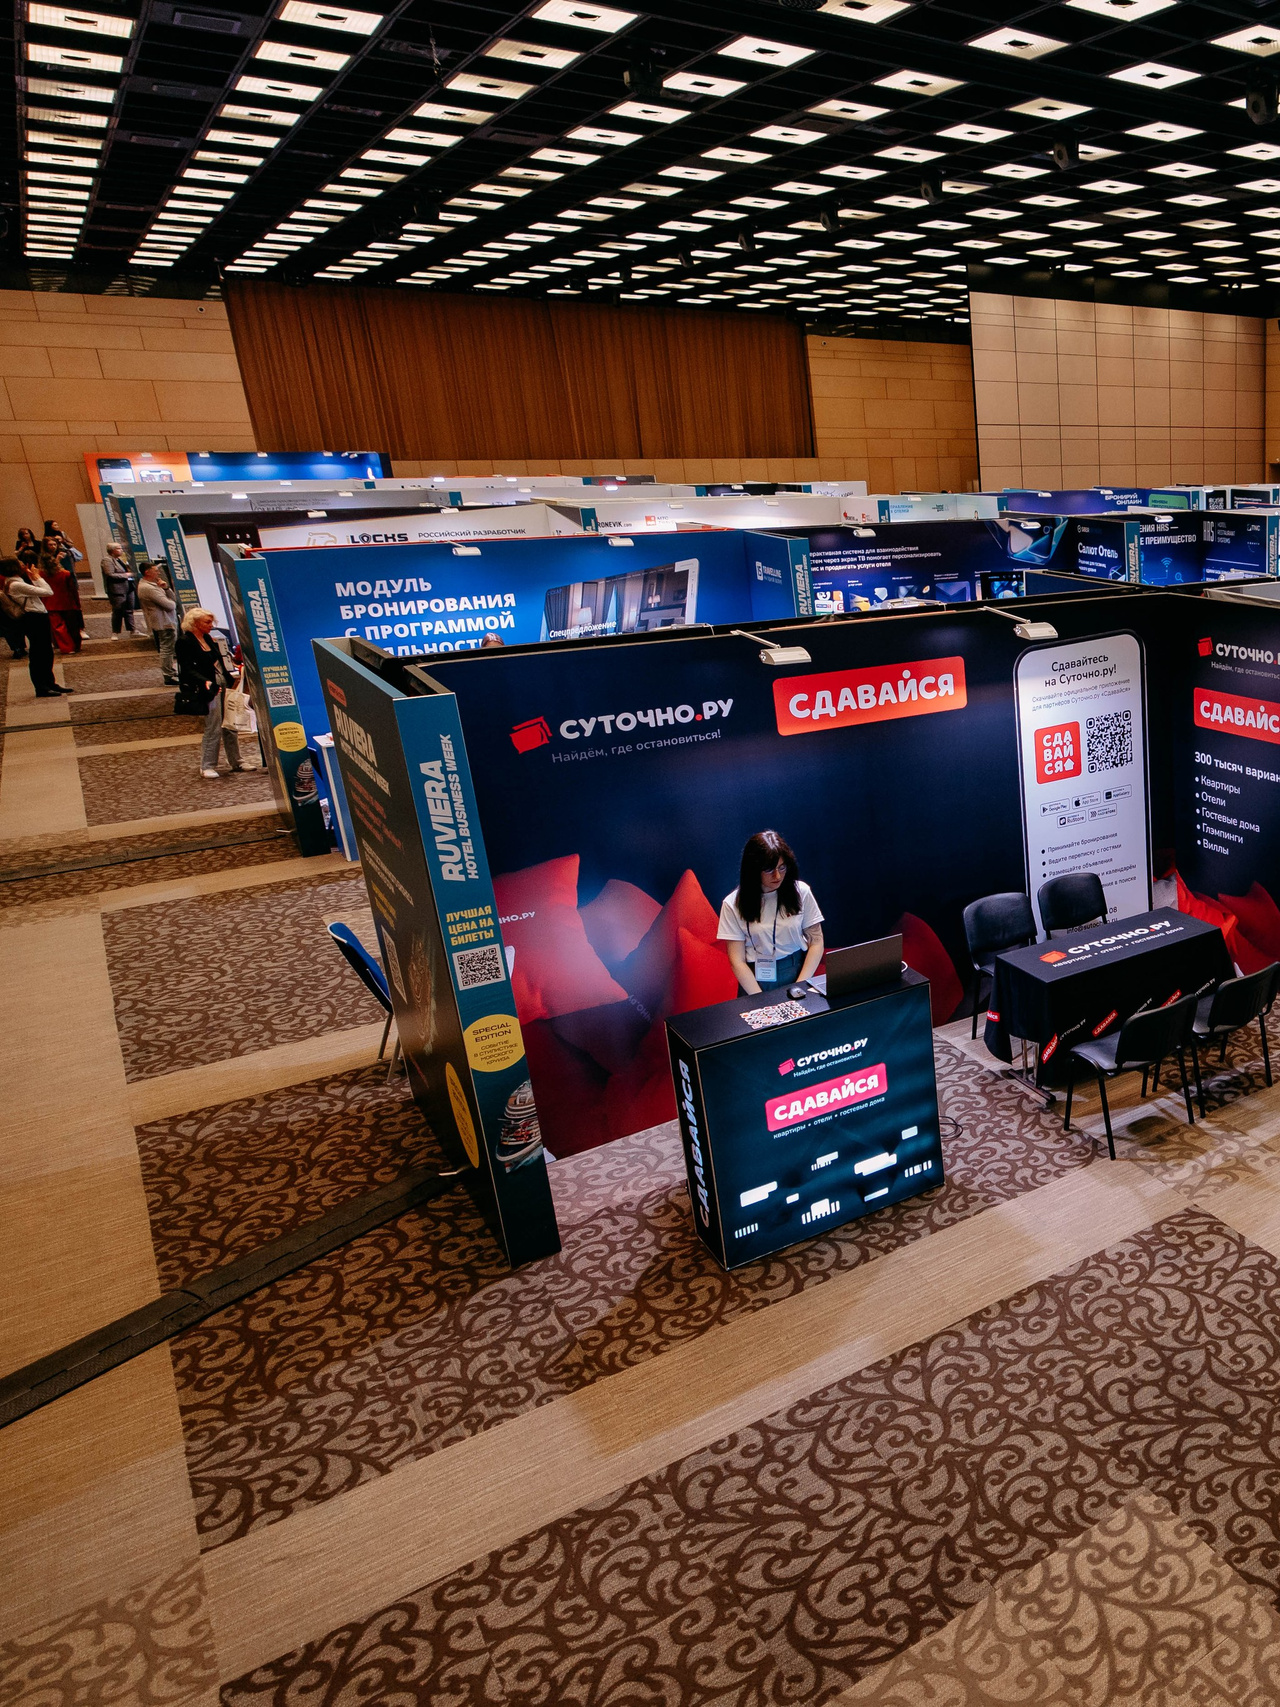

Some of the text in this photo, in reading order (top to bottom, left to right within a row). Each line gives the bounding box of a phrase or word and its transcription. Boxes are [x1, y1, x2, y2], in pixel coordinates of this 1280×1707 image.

[125, 513, 140, 545] RUVIERA
[418, 528, 526, 539] РОССИЙСКИЙ РАЗРАБОТЧИК
[1156, 524, 1169, 532] HRS
[876, 545, 919, 554] взаимодействия
[1077, 541, 1118, 559] Салют Отель
[1145, 534, 1197, 546] ПРЕИМУЩЕСТВО
[166, 538, 186, 580] RUVIERA
[824, 551, 942, 566] через помогает персонализировать
[825, 563, 857, 572] продвигать
[857, 562, 875, 571] услуги
[335, 577, 432, 598] МОДУЛЬ
[795, 564, 808, 615] RUVIERA
[339, 593, 517, 620] БРОНИРОВАНИЯ
[250, 589, 274, 653] RUVIERA
[344, 611, 516, 641] С ПРОГРАММОЙ
[549, 620, 617, 638] Спецпредложение
[1051, 653, 1109, 673] Сдавайтесь
[1210, 661, 1234, 673] Найдём,
[1234, 666, 1245, 675] где
[1044, 663, 1117, 687] на Суточно.ру!
[788, 669, 956, 720] СДАВАЙСЯ
[1032, 679, 1131, 703] Скачивайте официальное приложение
[1071, 693, 1100, 705] Суточно.ру
[559, 698, 734, 741] СУТОЧНО.РУ
[333, 704, 378, 768] RUVIERA
[551, 728, 722, 764] Найдём, где остановиться!
[1042, 730, 1073, 747] СДА
[1043, 742, 1074, 762] ВАЙ
[1044, 760, 1064, 776] СЯ
[1194, 751, 1213, 766] 300
[1213, 758, 1244, 774] тысяч
[1201, 775, 1241, 795] Квартиры
[439, 733, 479, 880] HOTEL BUSINESS WEEK
[1201, 791, 1227, 807] Отели
[419, 759, 467, 882] RUVIERA
[1201, 807, 1261, 833] Гостевые дома
[1047, 832, 1118, 853] Принимайте бронирования
[1202, 823, 1244, 844] Глэмпинги
[1048, 843, 1122, 866] Ведите переписку гостями
[1202, 838, 1229, 855] Виллы
[1082, 857, 1113, 870] объявления
[1105, 863, 1137, 876] календарём
[1118, 875, 1137, 885] поиске
[446, 905, 492, 923] ЛУЧШАЯ
[1108, 906, 1118, 914] 08
[448, 918, 494, 936] ЦЕНА НА
[450, 928, 495, 947] БИЛЕТЫ
[1053, 926, 1185, 968] квартиры отели гостевые дома
[1067, 920, 1172, 955] СУТОЧНО.РУ
[472, 1022, 512, 1036] SPECIAL
[474, 1029, 512, 1043] EDITION
[479, 1043, 518, 1057] СТИЛИСТИКЕ
[480, 1040, 510, 1051] СОБЫТИЕ
[480, 1049, 514, 1062] МОРСКОГО
[796, 1037, 869, 1068] СУТОЧНО.РУ
[486, 1055, 510, 1065] КРУИЗА
[793, 1051, 863, 1078] Найдём, остановиться!
[773, 1074, 880, 1121] СДАВАЙСЯ
[773, 1096, 886, 1140] квартиры отели гостевые дома
[678, 1058, 710, 1228] СДАВАЙСЯ
